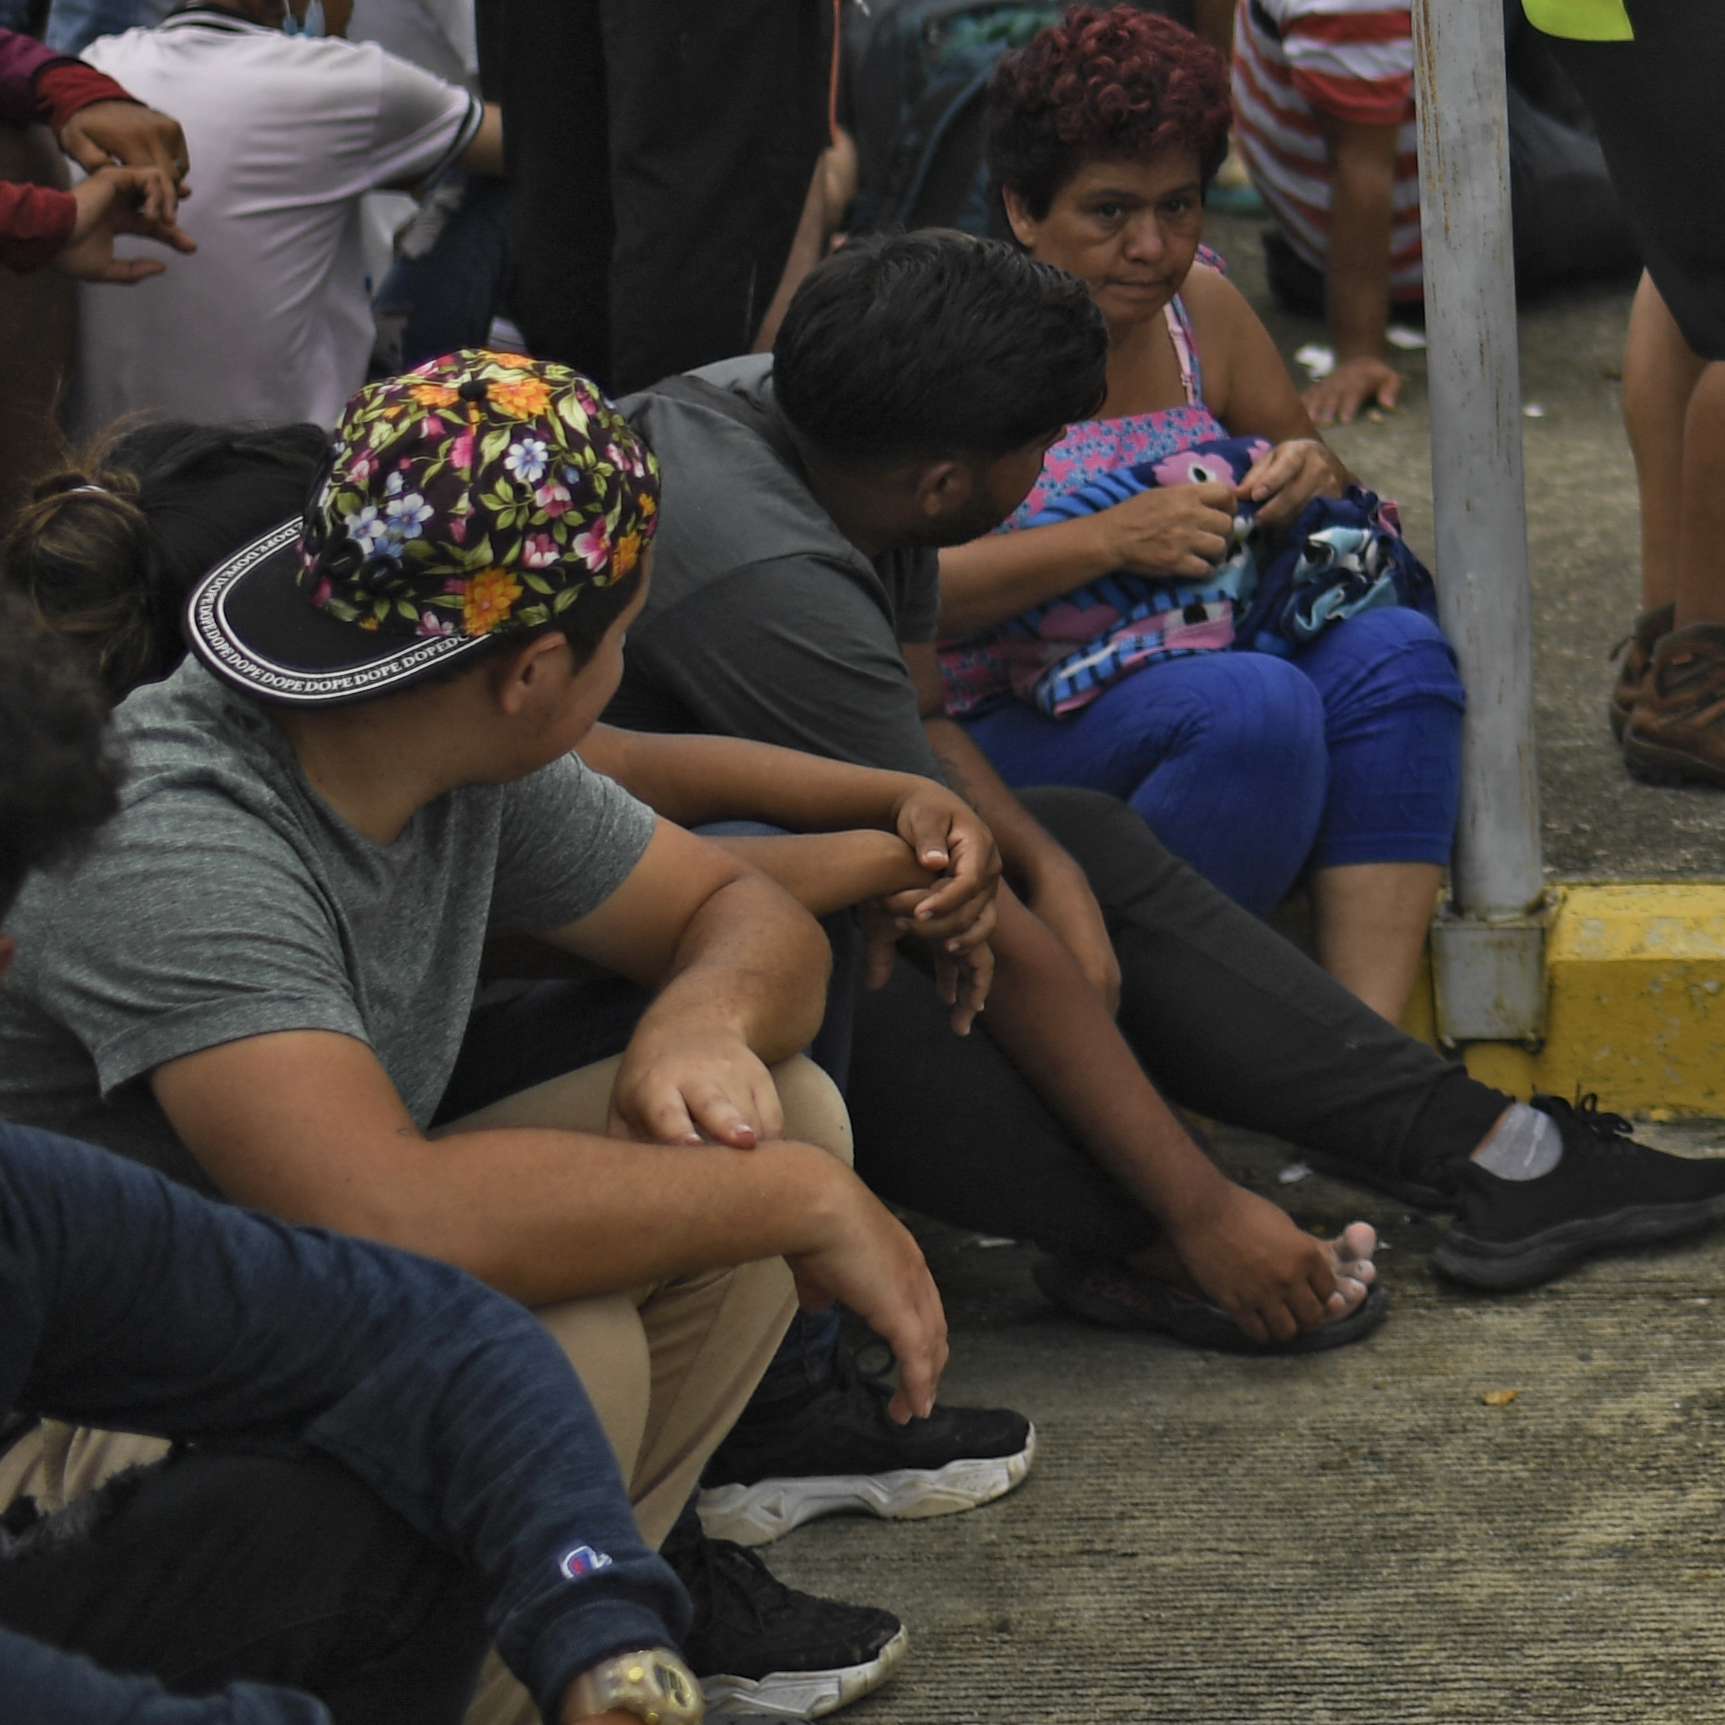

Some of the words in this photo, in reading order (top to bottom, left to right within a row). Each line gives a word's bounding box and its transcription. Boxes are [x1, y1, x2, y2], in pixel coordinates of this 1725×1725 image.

[199, 604, 218, 633] DOPE
[207, 629, 234, 658] DOPE
[403, 640, 449, 669] DOPE
[228, 651, 262, 679] DOPE
[353, 661, 404, 686] DOPE
[260, 672, 305, 692] DOPE
[304, 677, 354, 693] DOPE
